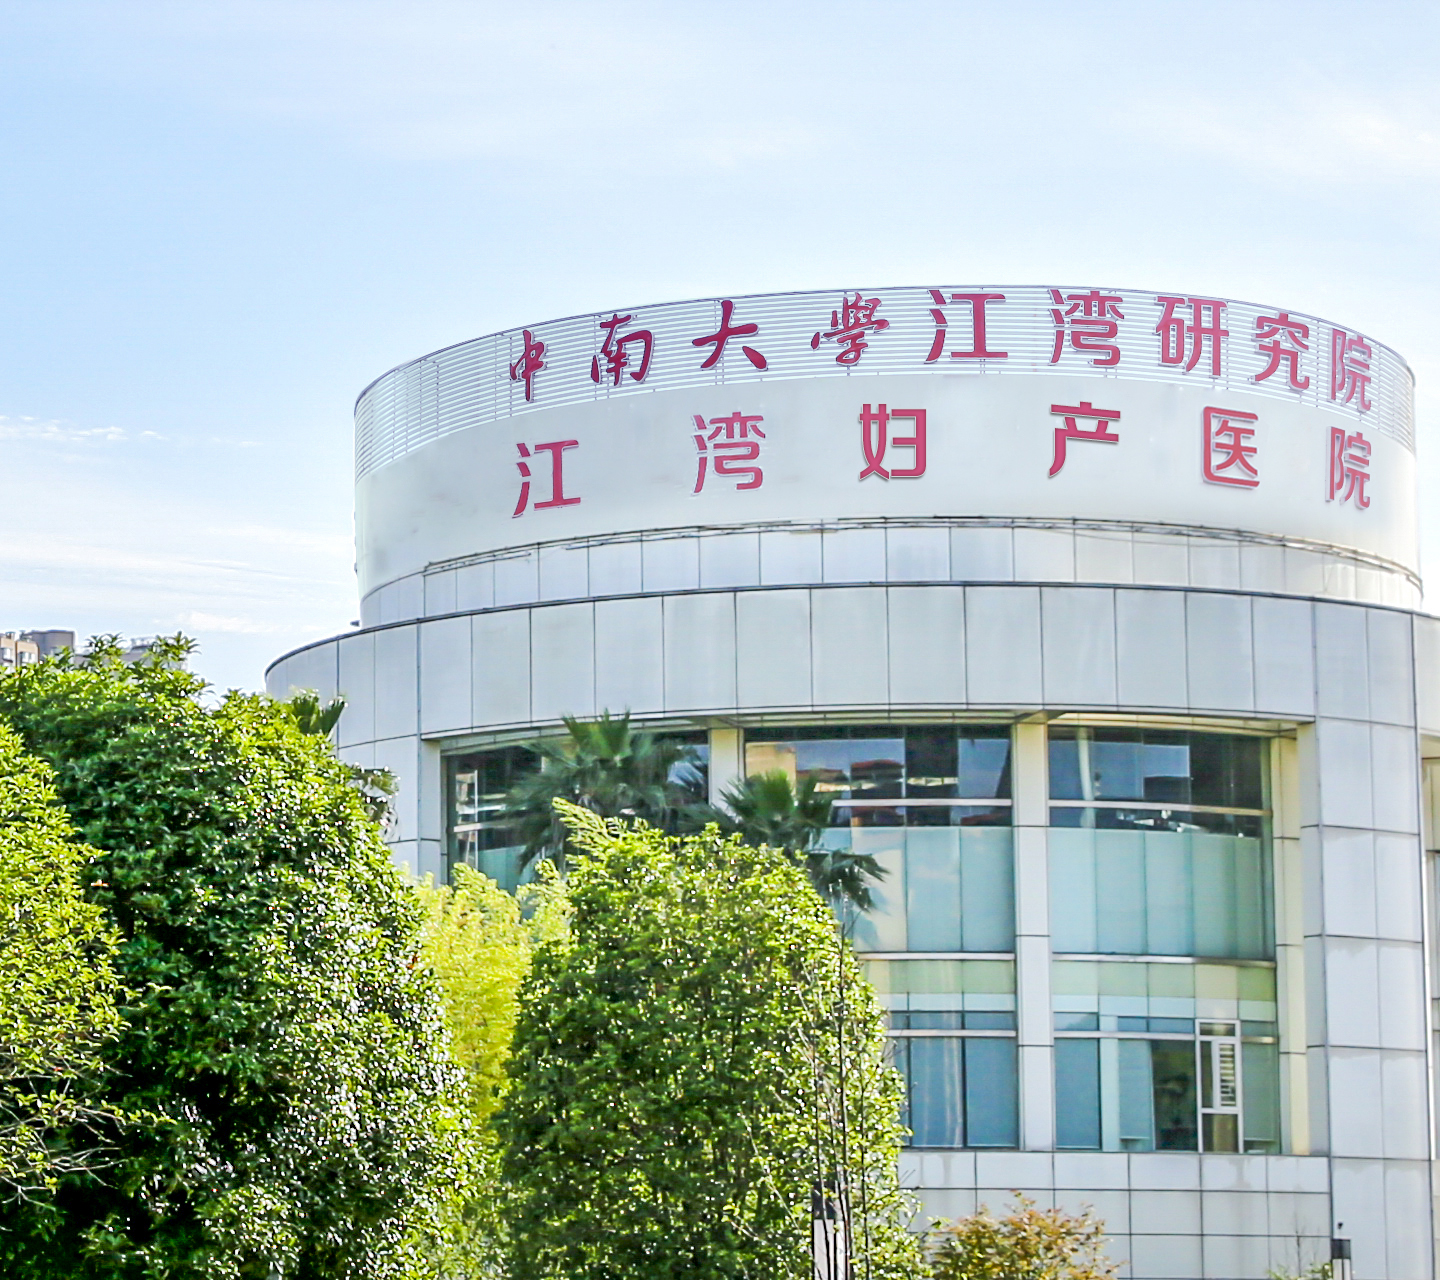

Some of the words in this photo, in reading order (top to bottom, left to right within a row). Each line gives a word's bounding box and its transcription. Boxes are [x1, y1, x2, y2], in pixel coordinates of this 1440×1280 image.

[512, 400, 1373, 518] 江湾妇产医院
